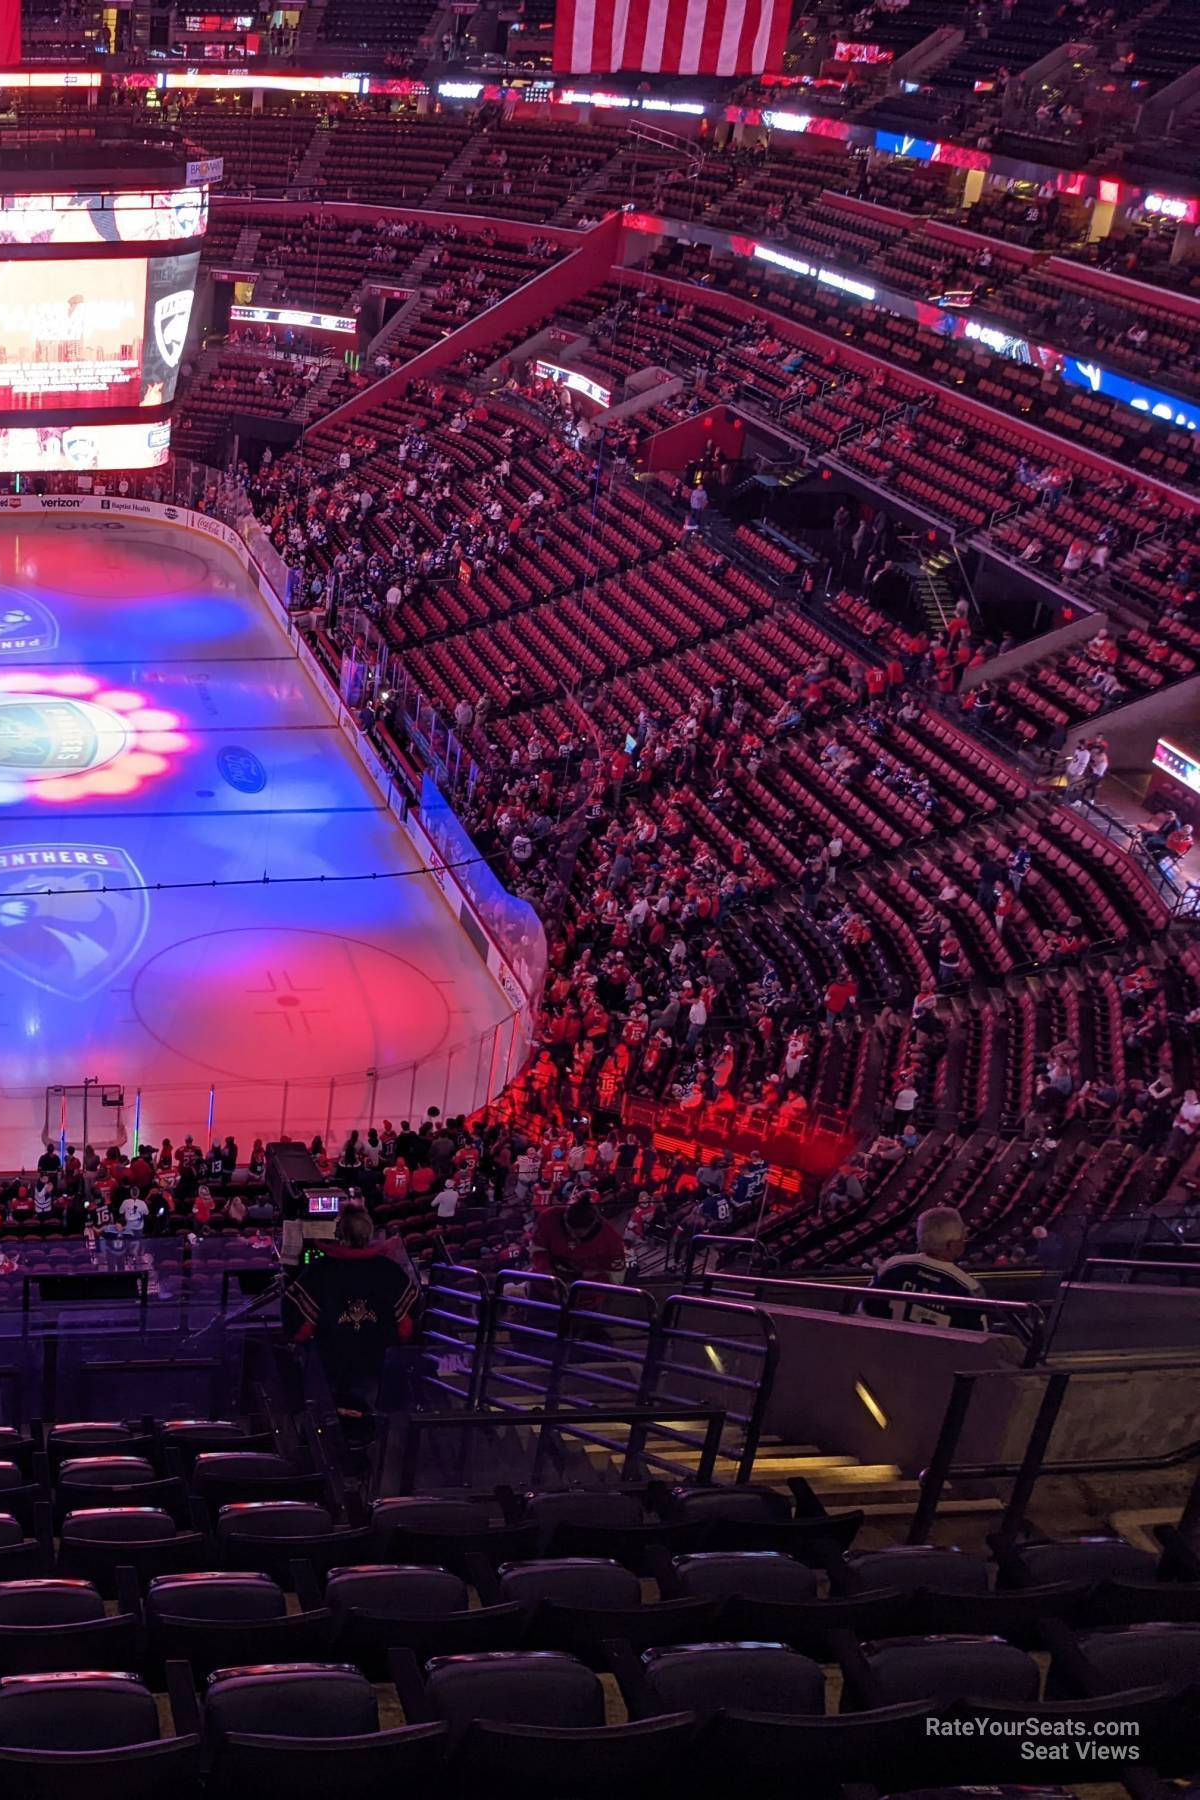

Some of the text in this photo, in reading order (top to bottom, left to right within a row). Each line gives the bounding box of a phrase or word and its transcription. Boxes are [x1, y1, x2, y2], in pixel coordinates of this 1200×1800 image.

[40, 497, 80, 508] verizon
[111, 502, 151, 513] Baptist Health
[211, 1160, 222, 1173] 13
[97, 1211, 110, 1225] 16
